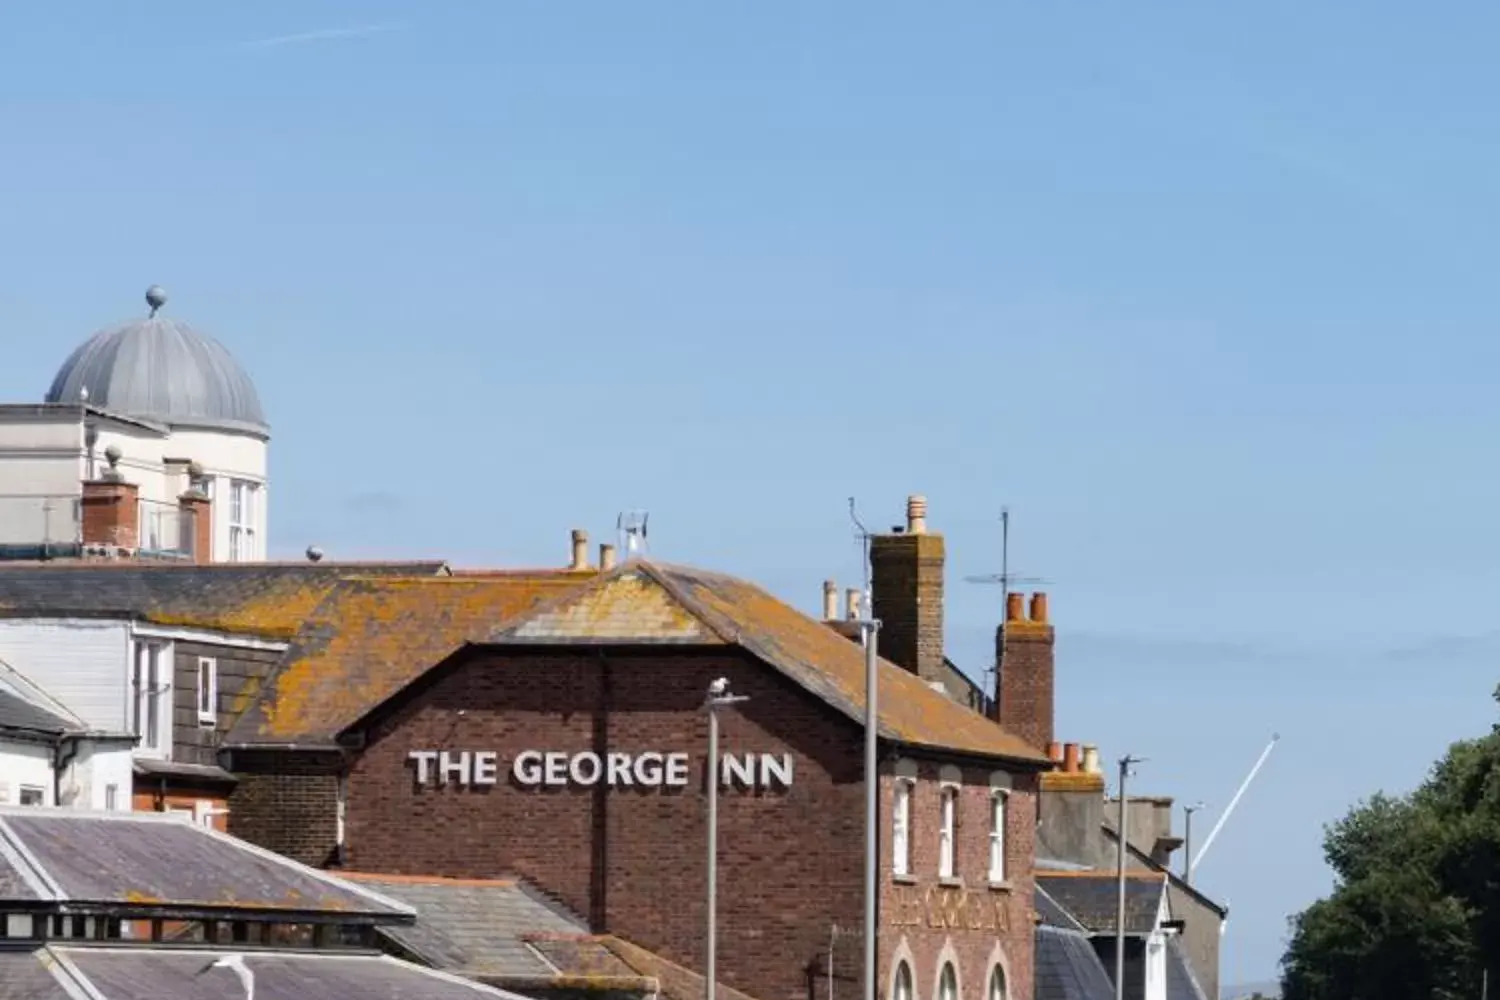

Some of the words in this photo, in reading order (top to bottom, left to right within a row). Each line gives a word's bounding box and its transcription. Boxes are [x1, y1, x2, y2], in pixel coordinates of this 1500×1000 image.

[409, 750, 497, 785] THE
[513, 750, 690, 786] GEORGE
[710, 752, 794, 786] NN
